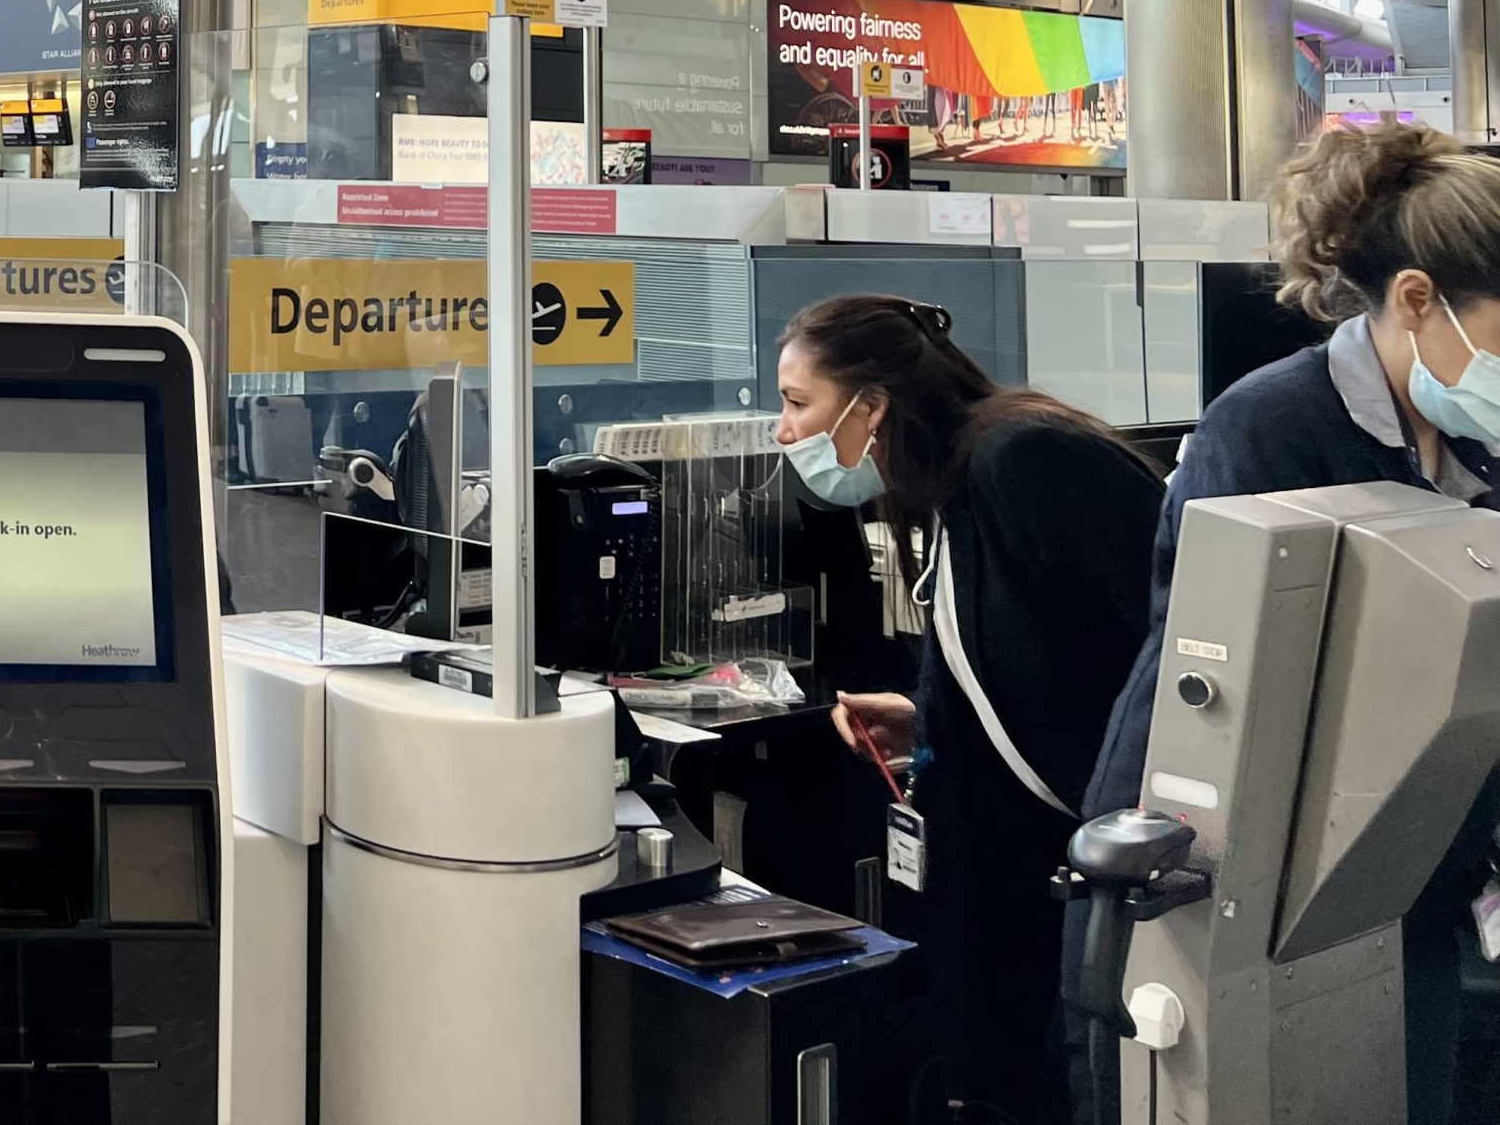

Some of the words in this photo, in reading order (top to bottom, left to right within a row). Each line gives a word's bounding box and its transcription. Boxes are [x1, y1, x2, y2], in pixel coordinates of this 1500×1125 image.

[779, 4, 856, 40] Powering
[860, 11, 922, 41] fairness
[42, 51, 59, 60] STAR
[779, 41, 812, 65] and
[680, 163, 693, 173] ARE
[342, 193, 373, 202] Restricted
[271, 287, 489, 346] Departure
[34, 522, 77, 542] open.
[82, 644, 140, 658] Heathrow
